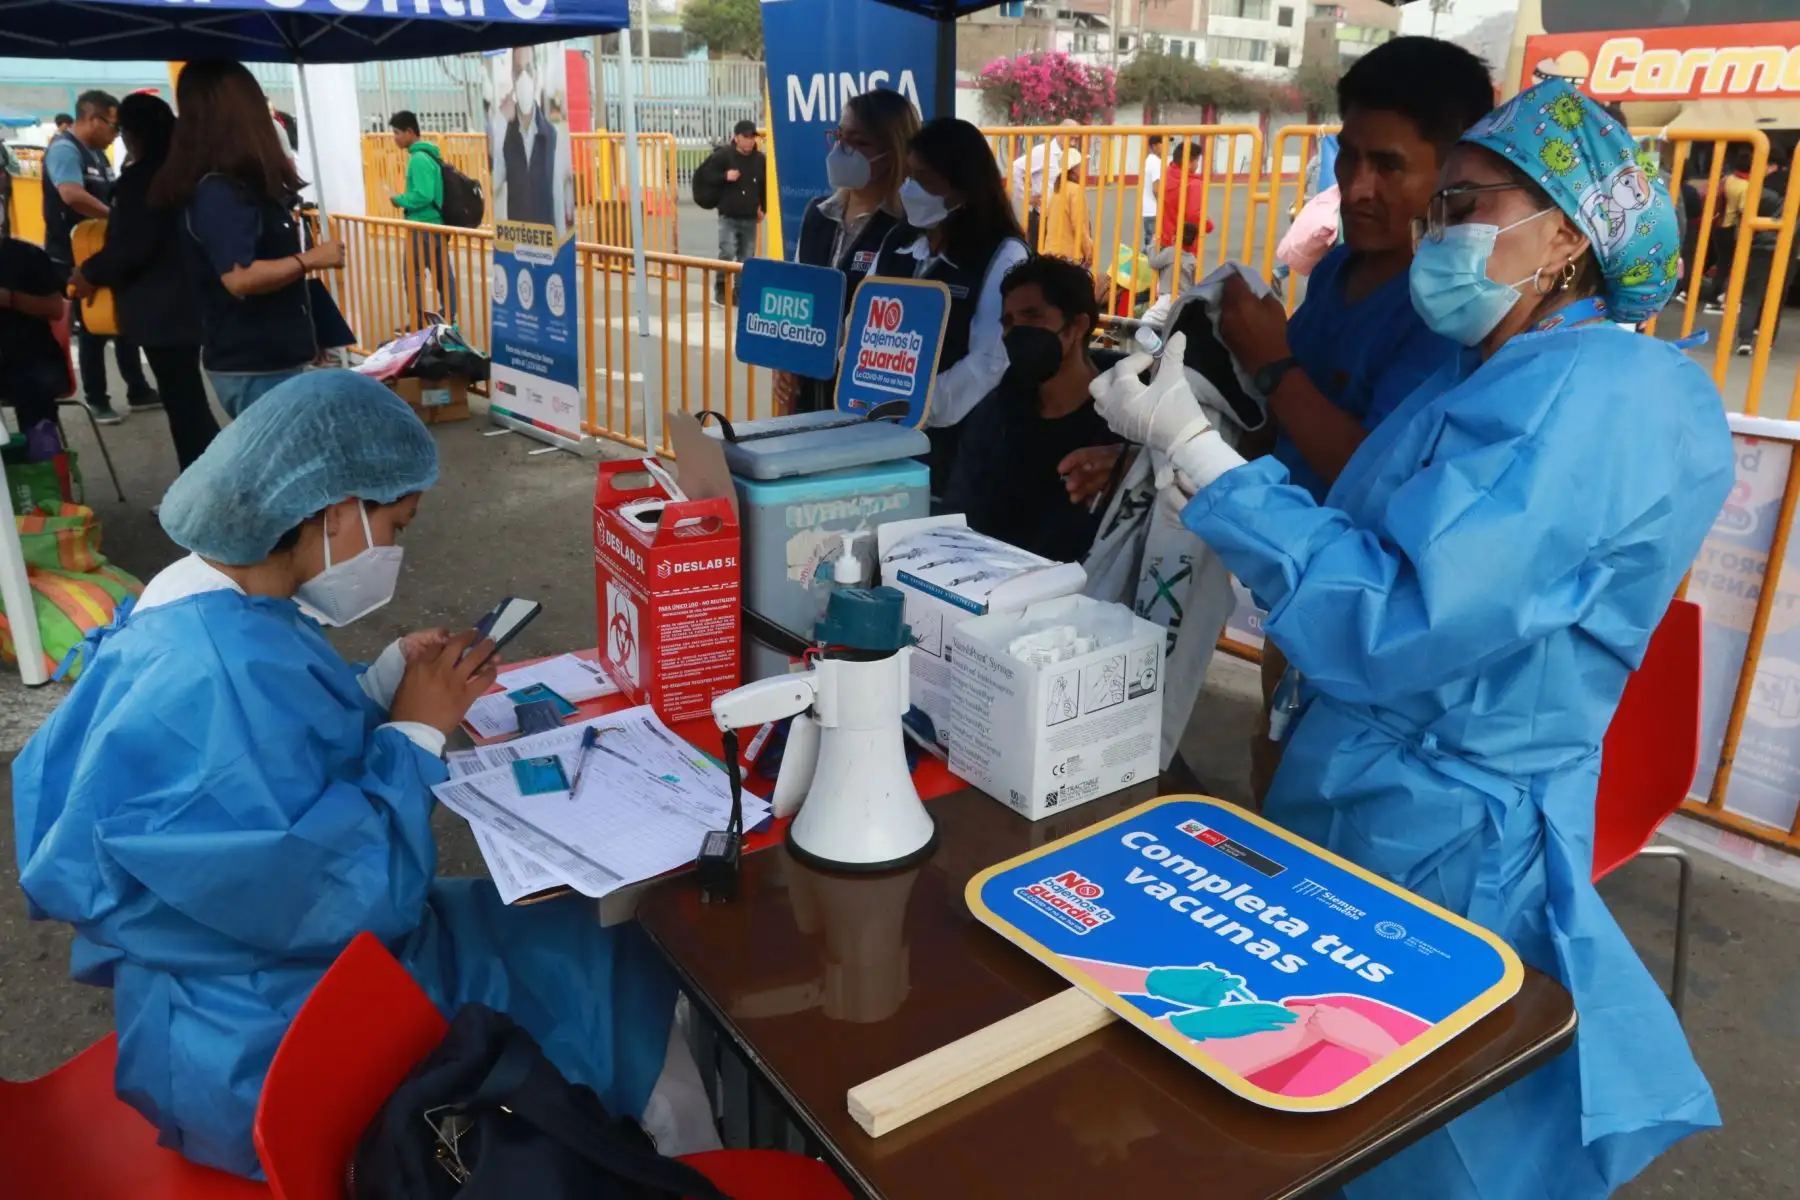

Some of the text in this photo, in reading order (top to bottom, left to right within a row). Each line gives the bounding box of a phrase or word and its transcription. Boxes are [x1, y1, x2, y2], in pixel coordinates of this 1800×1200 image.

[496, 223, 553, 247] PROTÉGETE
[764, 293, 809, 320] DIRIS
[868, 299, 901, 332] NO
[748, 314, 825, 344] Lima Centro
[863, 330, 921, 351] bajemos la
[858, 349, 917, 374] guardia
[606, 530, 635, 567] DESLAB
[636, 556, 645, 575] 5L
[674, 557, 737, 574] DESLAB 5L
[1055, 872, 1101, 898] NO
[1027, 885, 1101, 928] guardia
[1044, 879, 1112, 921] bajemos la
[1121, 831, 1394, 983] Completa tus
[1322, 891, 1367, 918] Siempre
[1329, 902, 1360, 921] pueblo
[1124, 867, 1308, 974] vacunas
